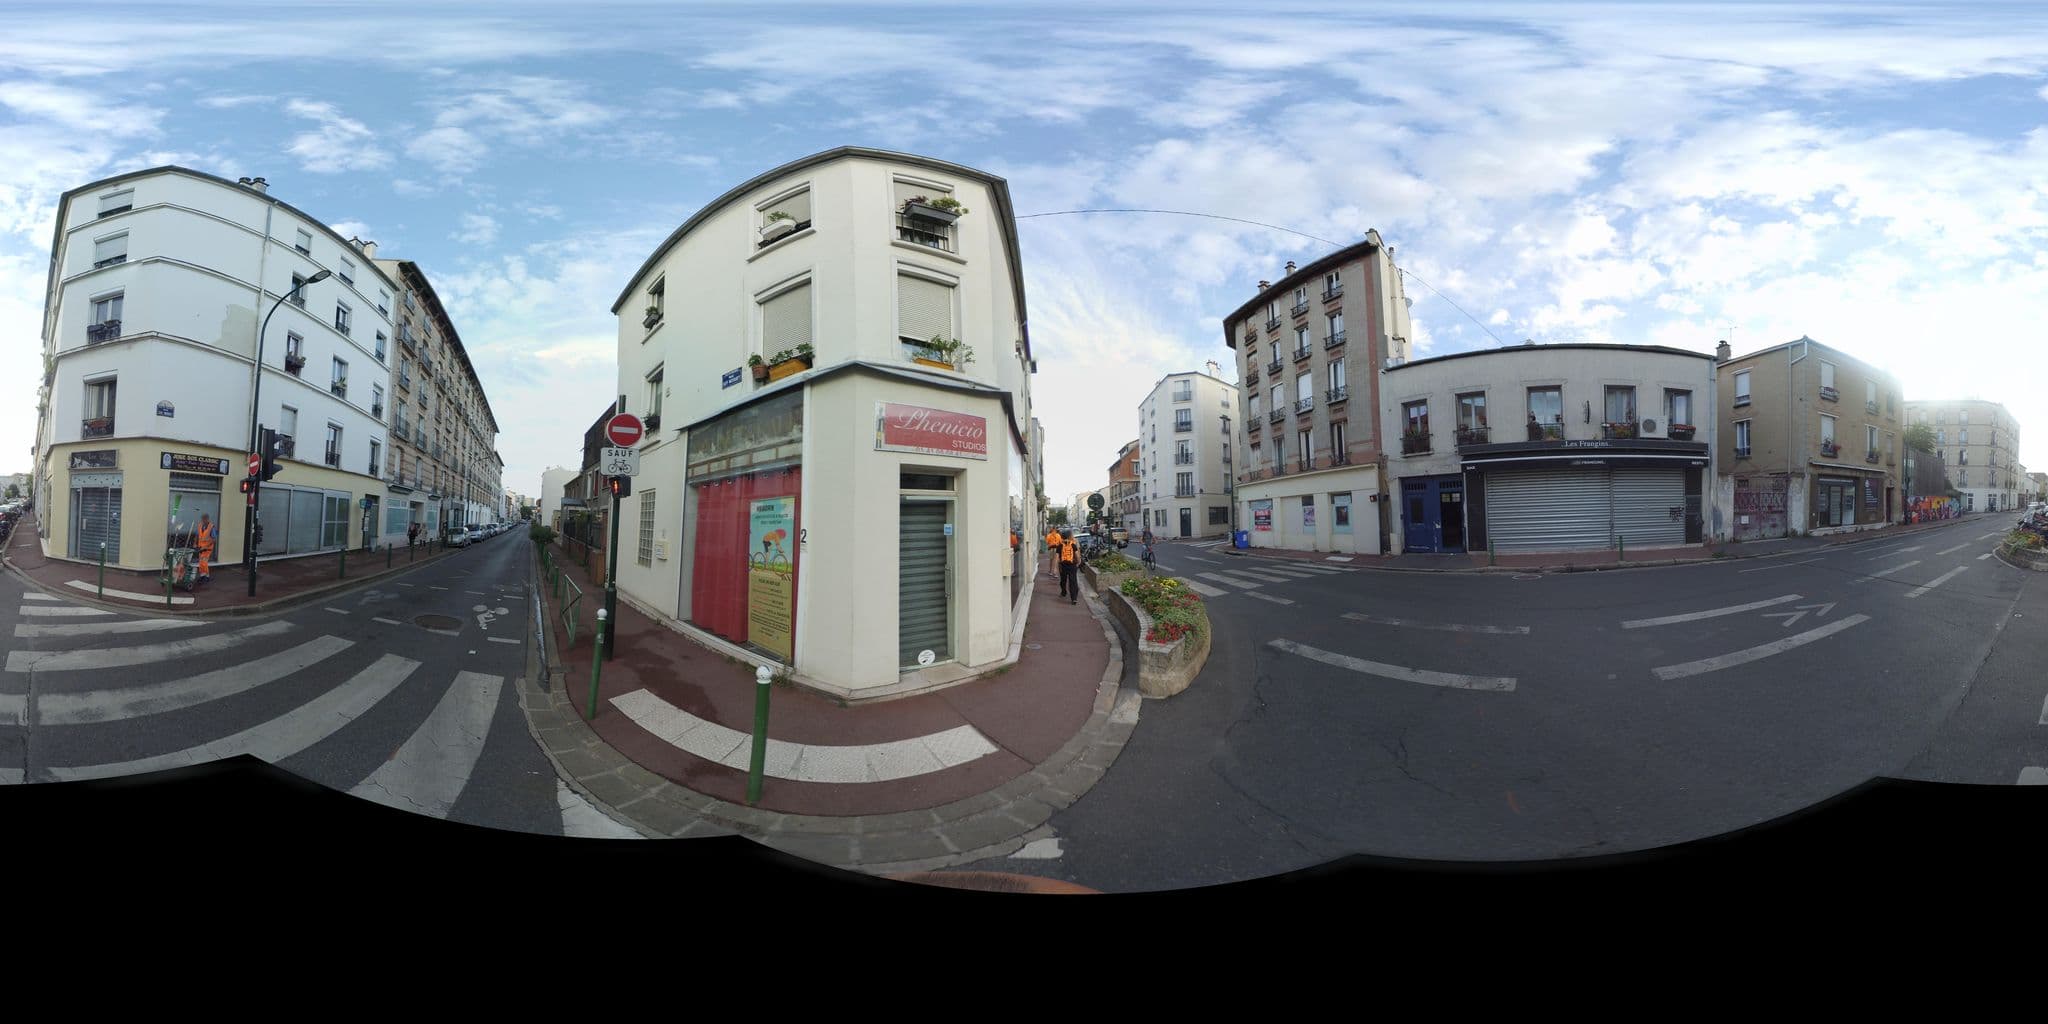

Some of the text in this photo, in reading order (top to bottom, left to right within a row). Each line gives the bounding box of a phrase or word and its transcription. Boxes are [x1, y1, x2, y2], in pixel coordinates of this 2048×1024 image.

[893, 409, 984, 438] Phenicio
[952, 440, 986, 452] STUDIOS
[800, 528, 807, 544] 2
